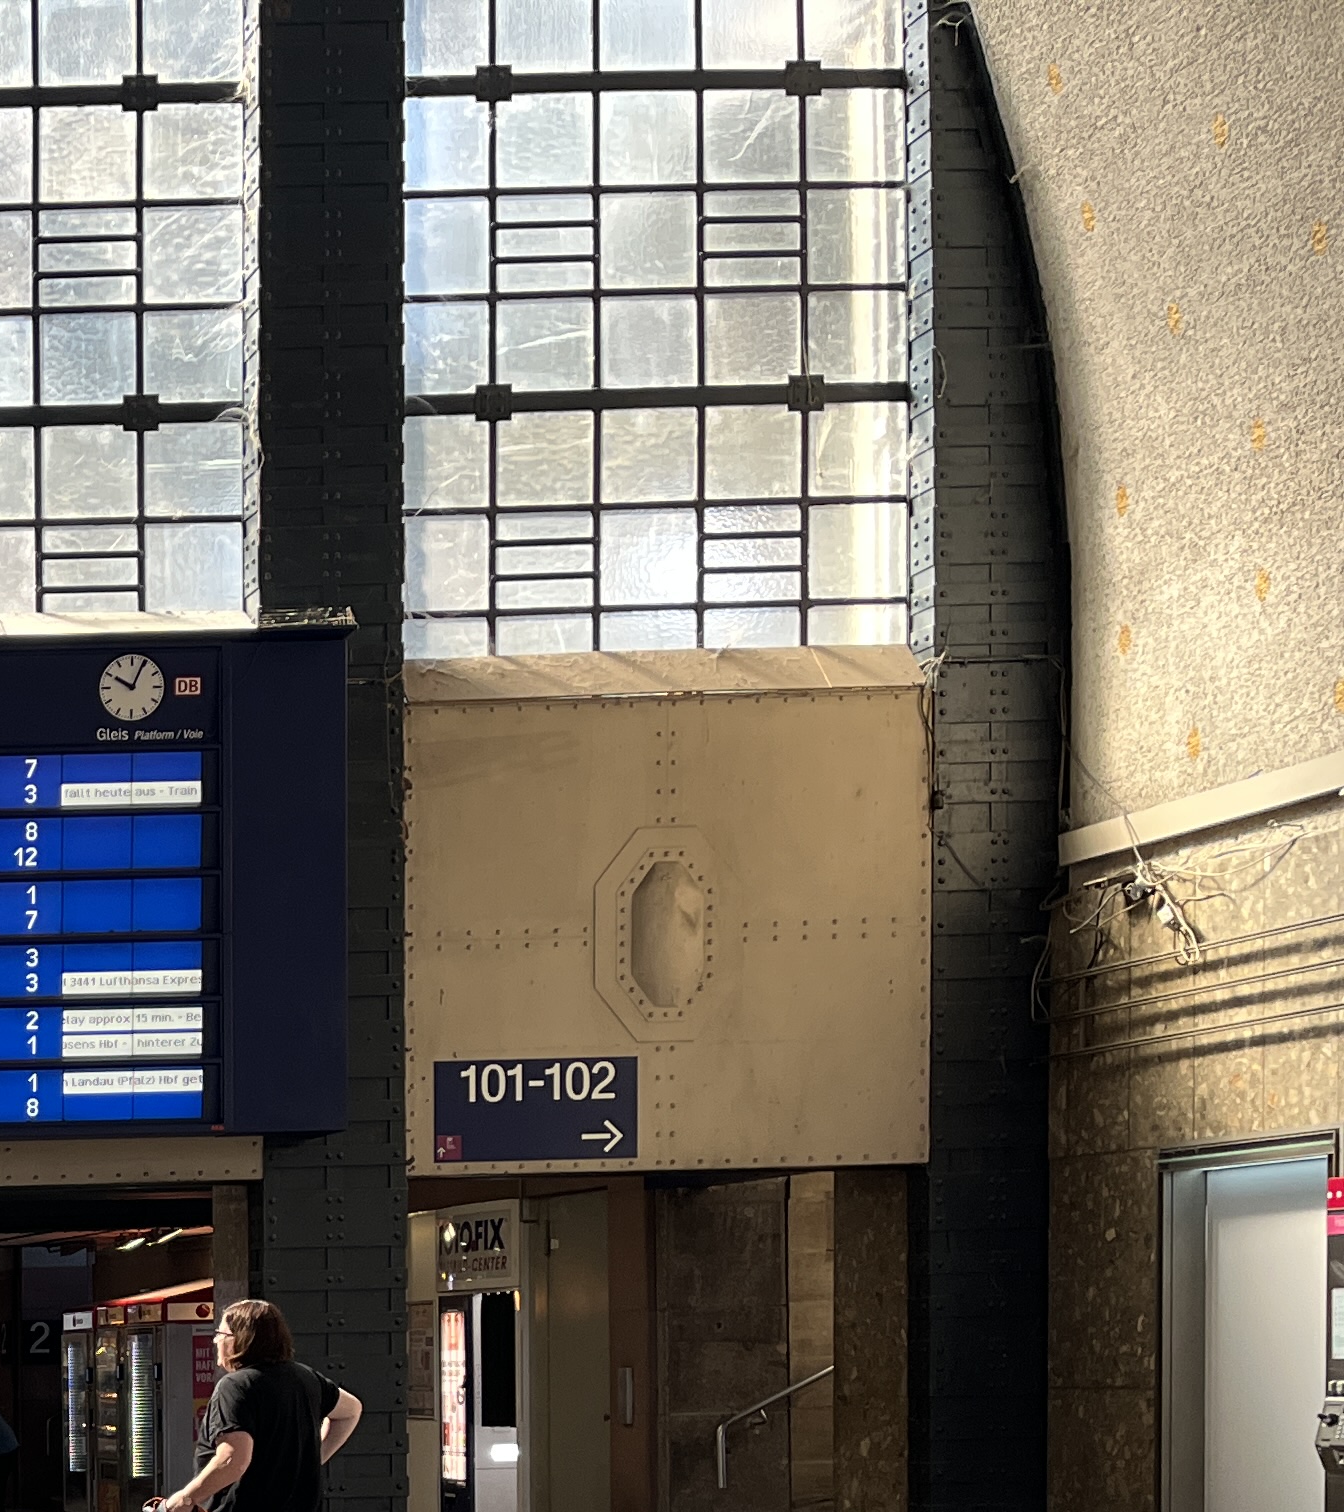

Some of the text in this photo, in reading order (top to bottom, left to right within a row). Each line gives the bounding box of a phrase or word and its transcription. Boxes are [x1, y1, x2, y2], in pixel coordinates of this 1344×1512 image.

[177, 680, 199, 693] DB
[96, 728, 203, 741] Gleis Platform Voie
[460, 1061, 616, 1103] 101-102
[29, 1321, 50, 1354] 2
